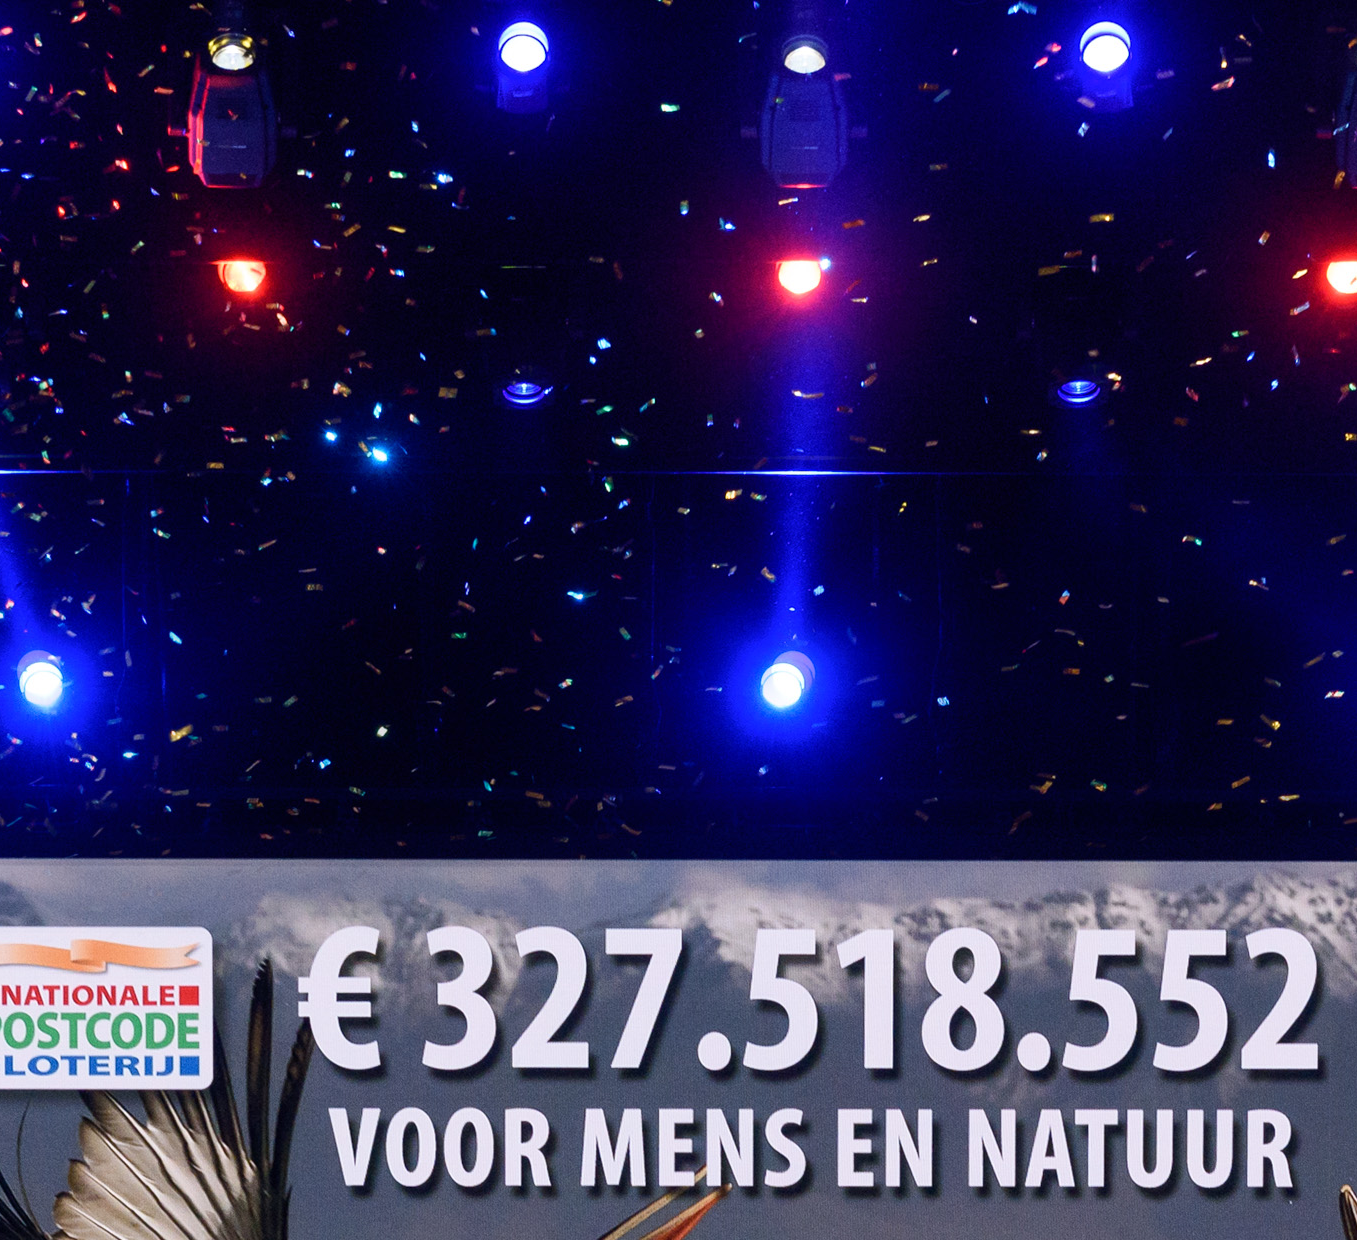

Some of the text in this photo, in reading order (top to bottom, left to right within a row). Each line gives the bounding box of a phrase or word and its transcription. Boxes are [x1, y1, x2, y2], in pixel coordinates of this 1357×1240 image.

[1, 984, 175, 1006] NATIONALE
[297, 924, 1320, 1072] € 327.518.552
[4, 1054, 174, 1076] LOTERIJ
[327, 1107, 1294, 1189] VOOR MENS EN NATUUR
